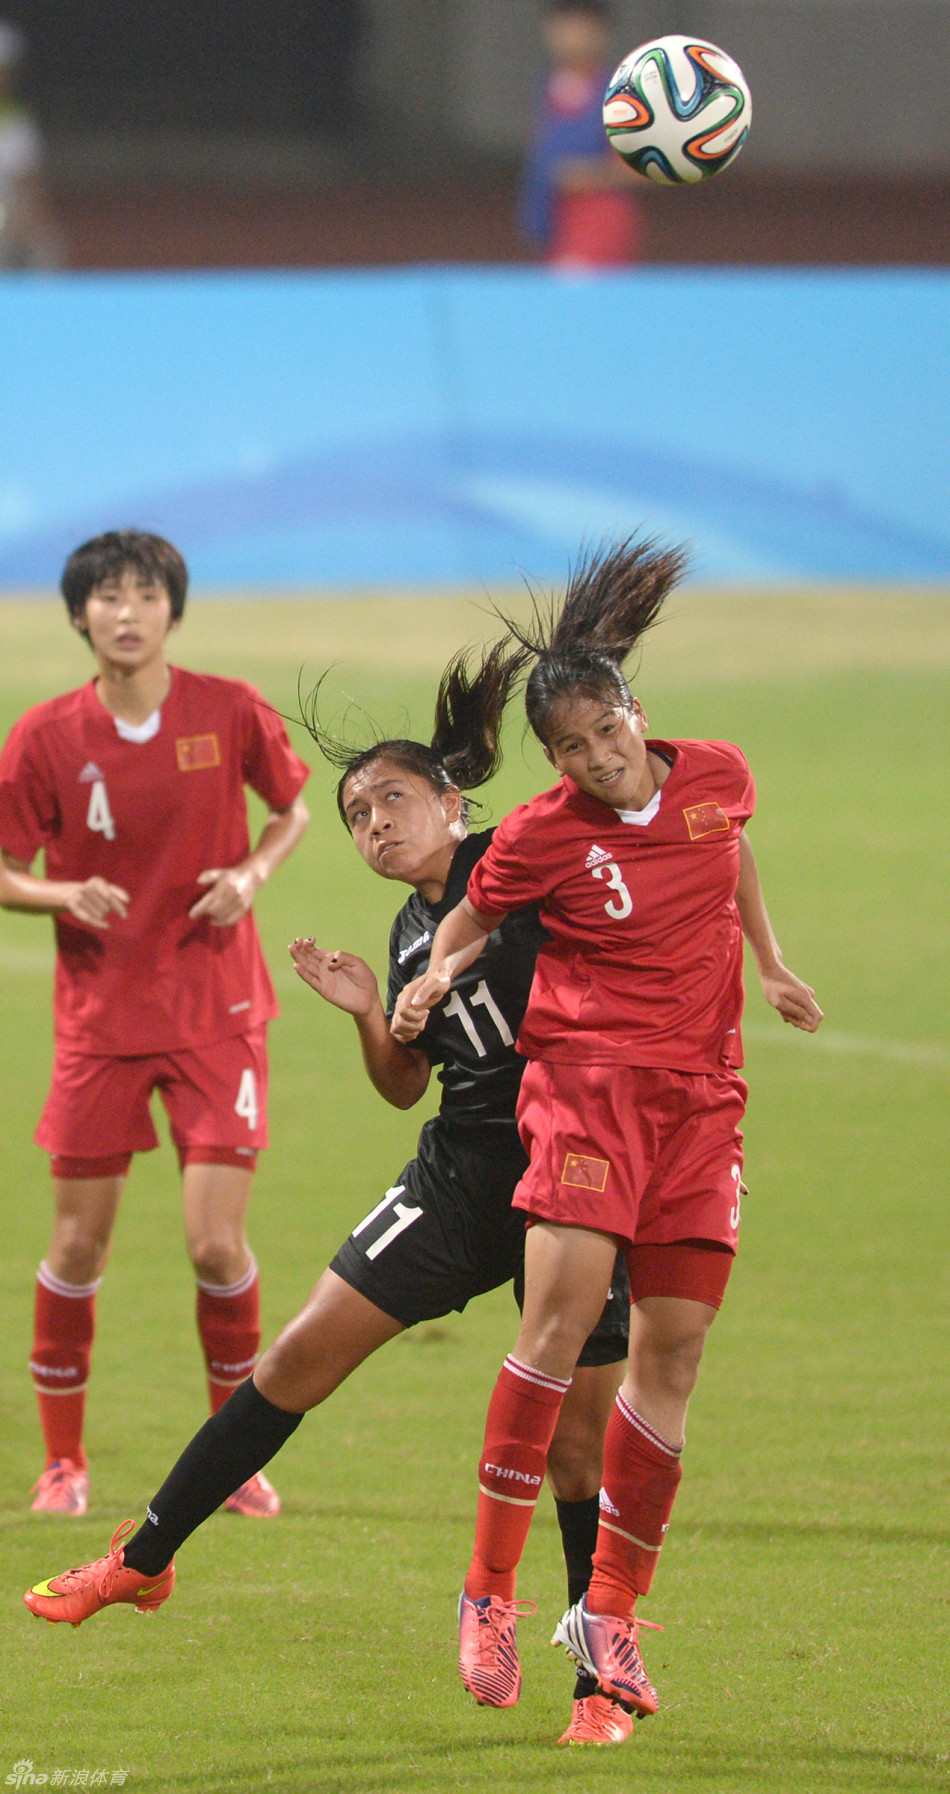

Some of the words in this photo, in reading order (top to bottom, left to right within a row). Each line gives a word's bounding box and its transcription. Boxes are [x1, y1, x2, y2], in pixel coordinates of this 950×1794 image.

[86, 781, 116, 841] 4
[584, 852, 613, 869] adidas
[591, 861, 633, 920] 3
[442, 980, 515, 1058] 11
[234, 1068, 258, 1131] 4
[351, 1184, 424, 1261] 11
[730, 1164, 741, 1230] 3
